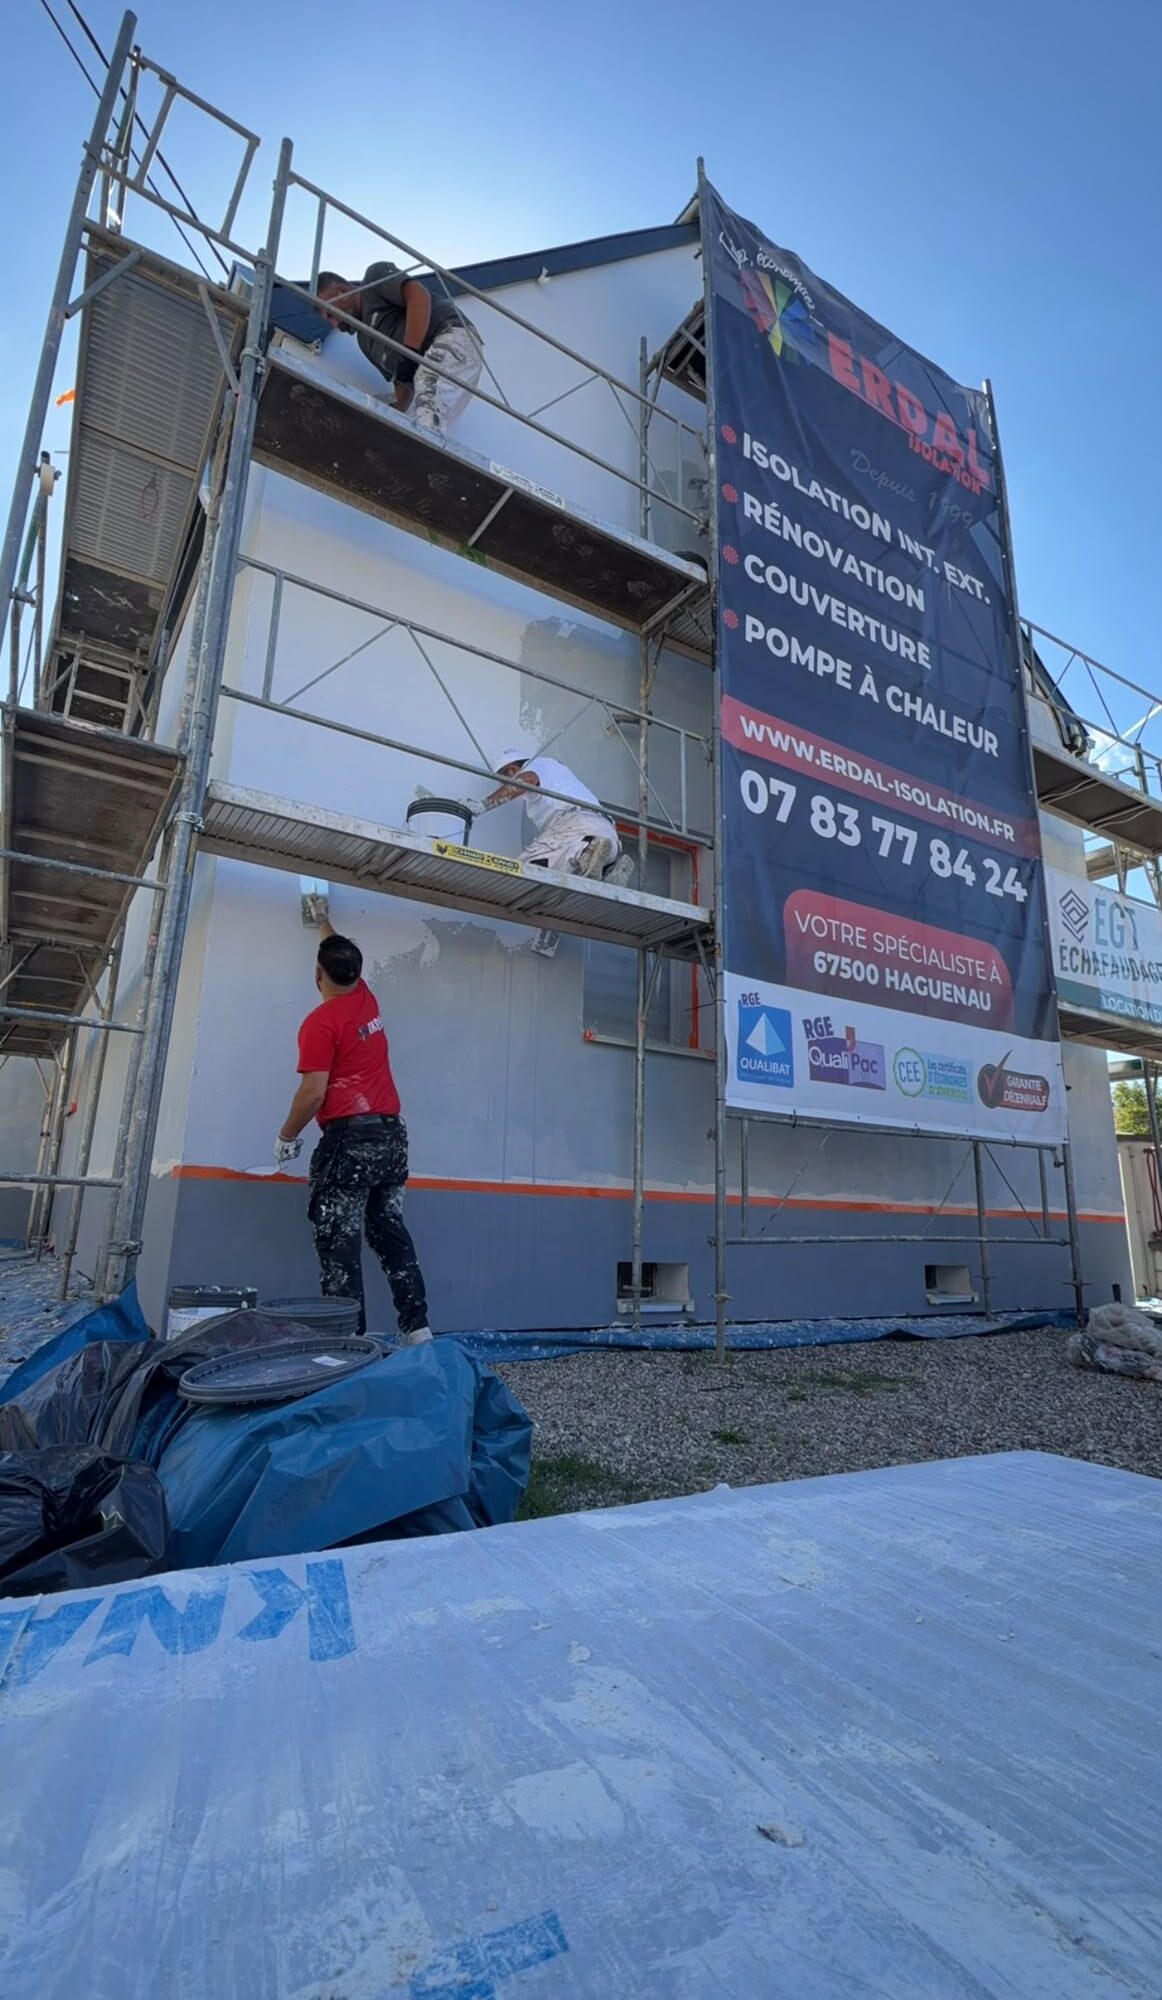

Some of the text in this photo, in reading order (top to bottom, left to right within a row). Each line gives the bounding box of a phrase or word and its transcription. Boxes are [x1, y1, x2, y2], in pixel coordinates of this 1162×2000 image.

[827, 330, 990, 487] ERDAL
[850, 448, 917, 502] Depuis
[743, 432, 991, 605] ISOLATION INT. EXT.
[743, 491, 925, 613] RÉNOVATION
[743, 554, 932, 670] COUVERTURE
[745, 614, 999, 758] POMPE À CHALEUR
[740, 714, 1015, 842] WWW.ERDAL-ISOLATION.FR
[739, 769, 1028, 903] 07 83 77 84 24
[794, 909, 1003, 986] VOTRE SPÉCIALISTE À
[1094, 897, 1139, 952] EGT
[741, 992, 761, 1006] RGE
[813, 950, 992, 1012] 67500 HAGUENAU
[802, 1016, 834, 1040] RGE
[740, 1057, 791, 1076] QUALIBAT
[898, 1061, 921, 1083] CEE
[1006, 1075, 1043, 1092] GARANTIE
[1003, 1090, 1047, 1106] DÉCENNALE
